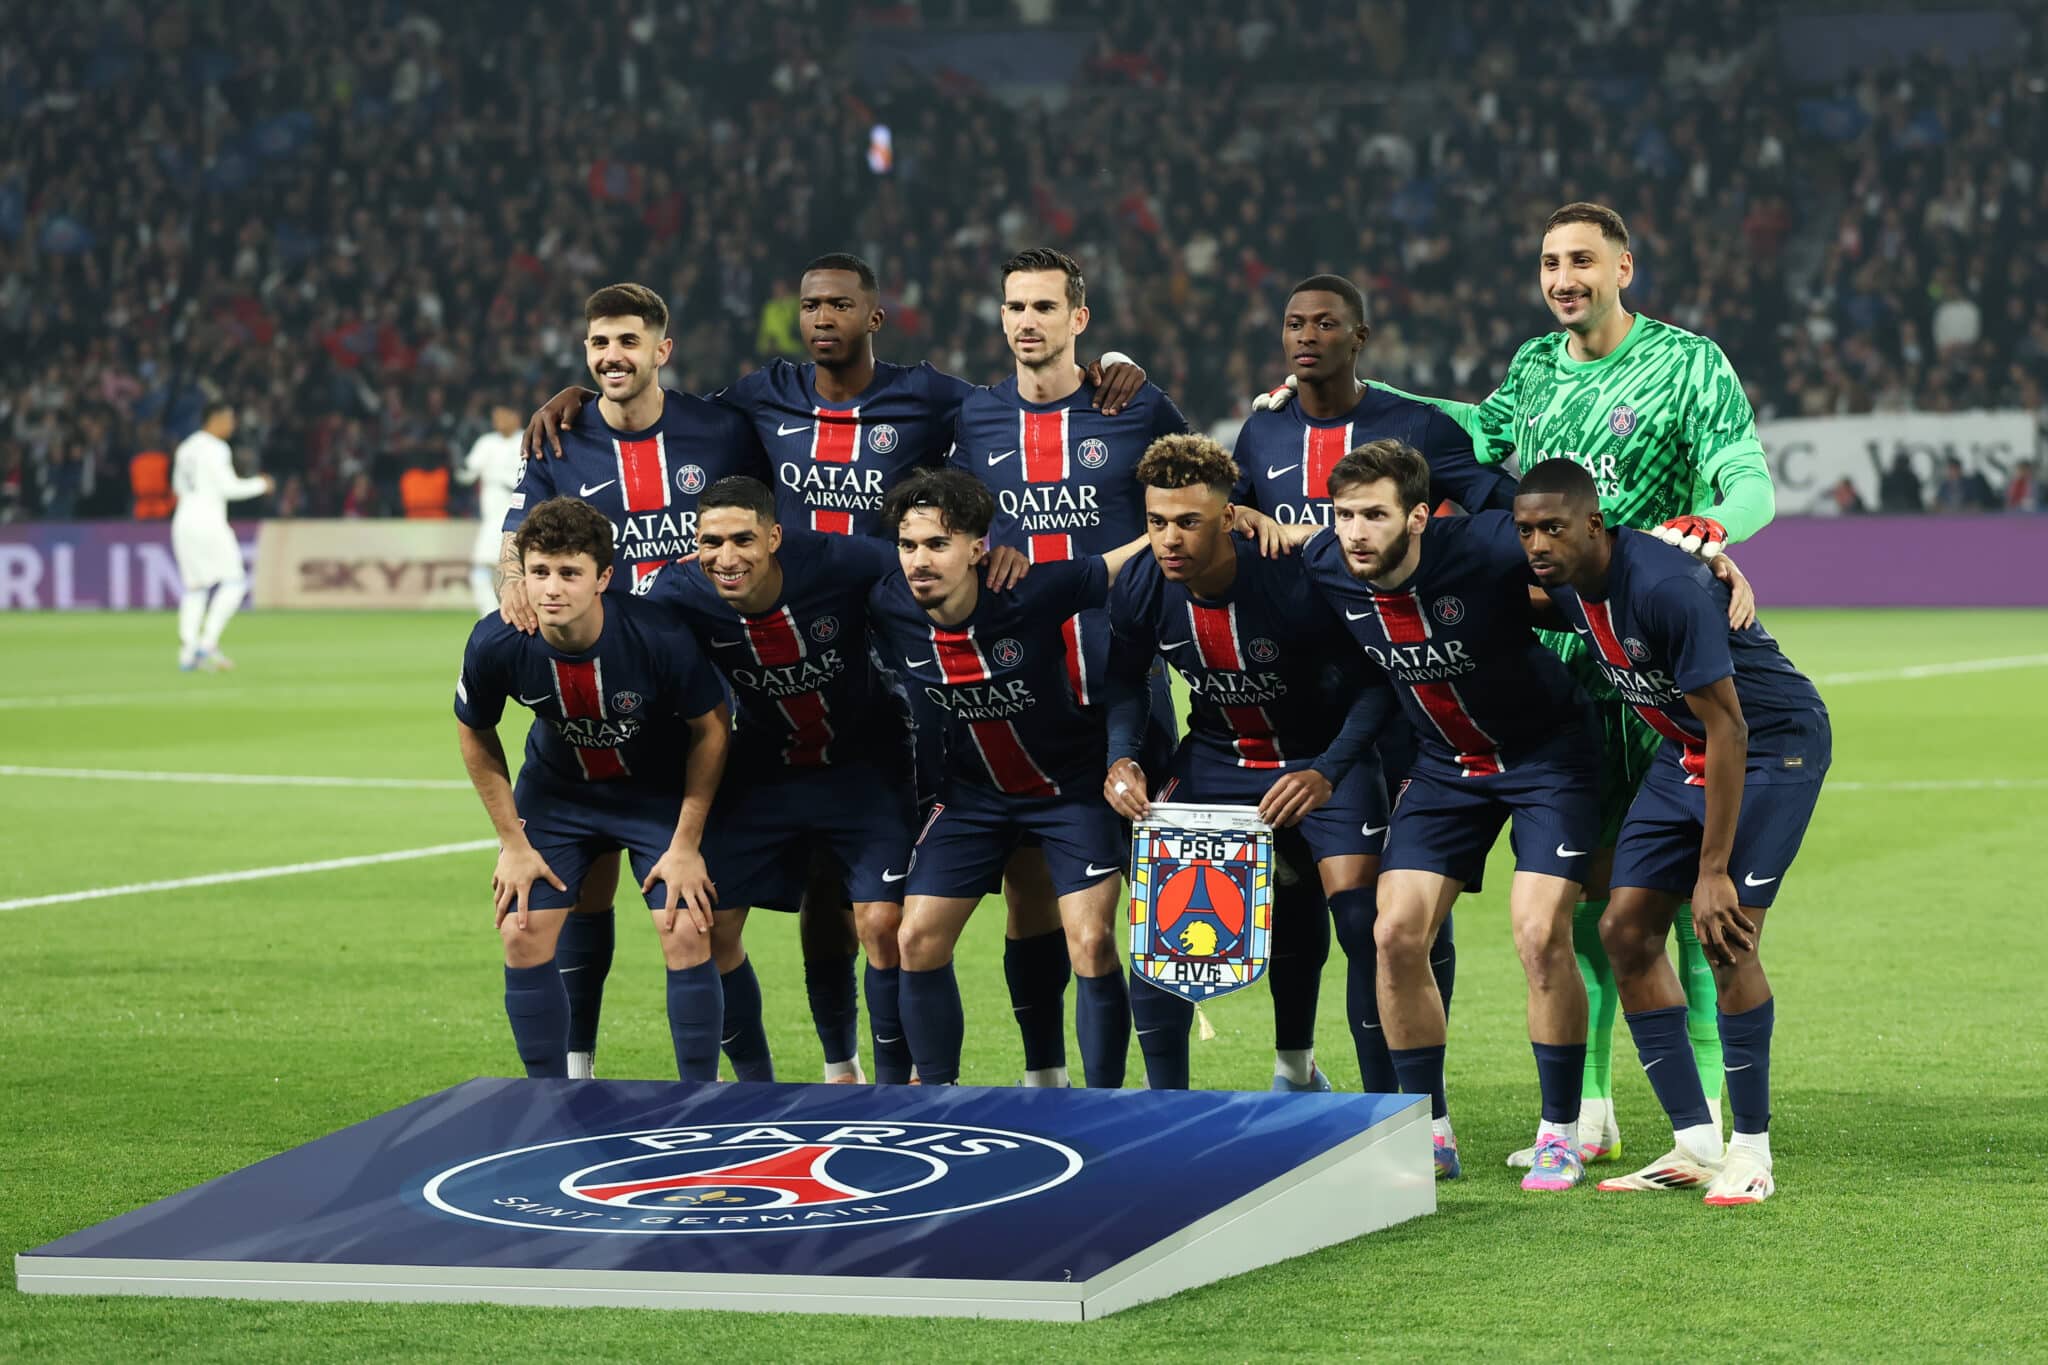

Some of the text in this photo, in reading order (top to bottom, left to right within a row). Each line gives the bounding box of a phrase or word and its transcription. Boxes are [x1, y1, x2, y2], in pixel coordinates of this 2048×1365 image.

[1537, 449, 1619, 480] TAR
[780, 462, 884, 493] QATAR
[804, 490, 883, 510] AIRWAYS
[999, 485, 1098, 519] QATAR
[1021, 511, 1100, 531] AIRWAYS
[1275, 503, 1335, 526] QAT
[623, 537, 699, 560] AIRWAYS
[1364, 640, 1470, 670] QATAR
[732, 649, 842, 690] QATAR
[1180, 669, 1280, 695] QATAR
[1397, 658, 1476, 681] AIRWAYS
[925, 679, 1030, 711] QATAR
[1209, 680, 1287, 704] AIRWAYS
[957, 694, 1036, 719] AIRWAYS
[1180, 840, 1226, 861] PSG
[628, 1125, 1022, 1156] PARIS
